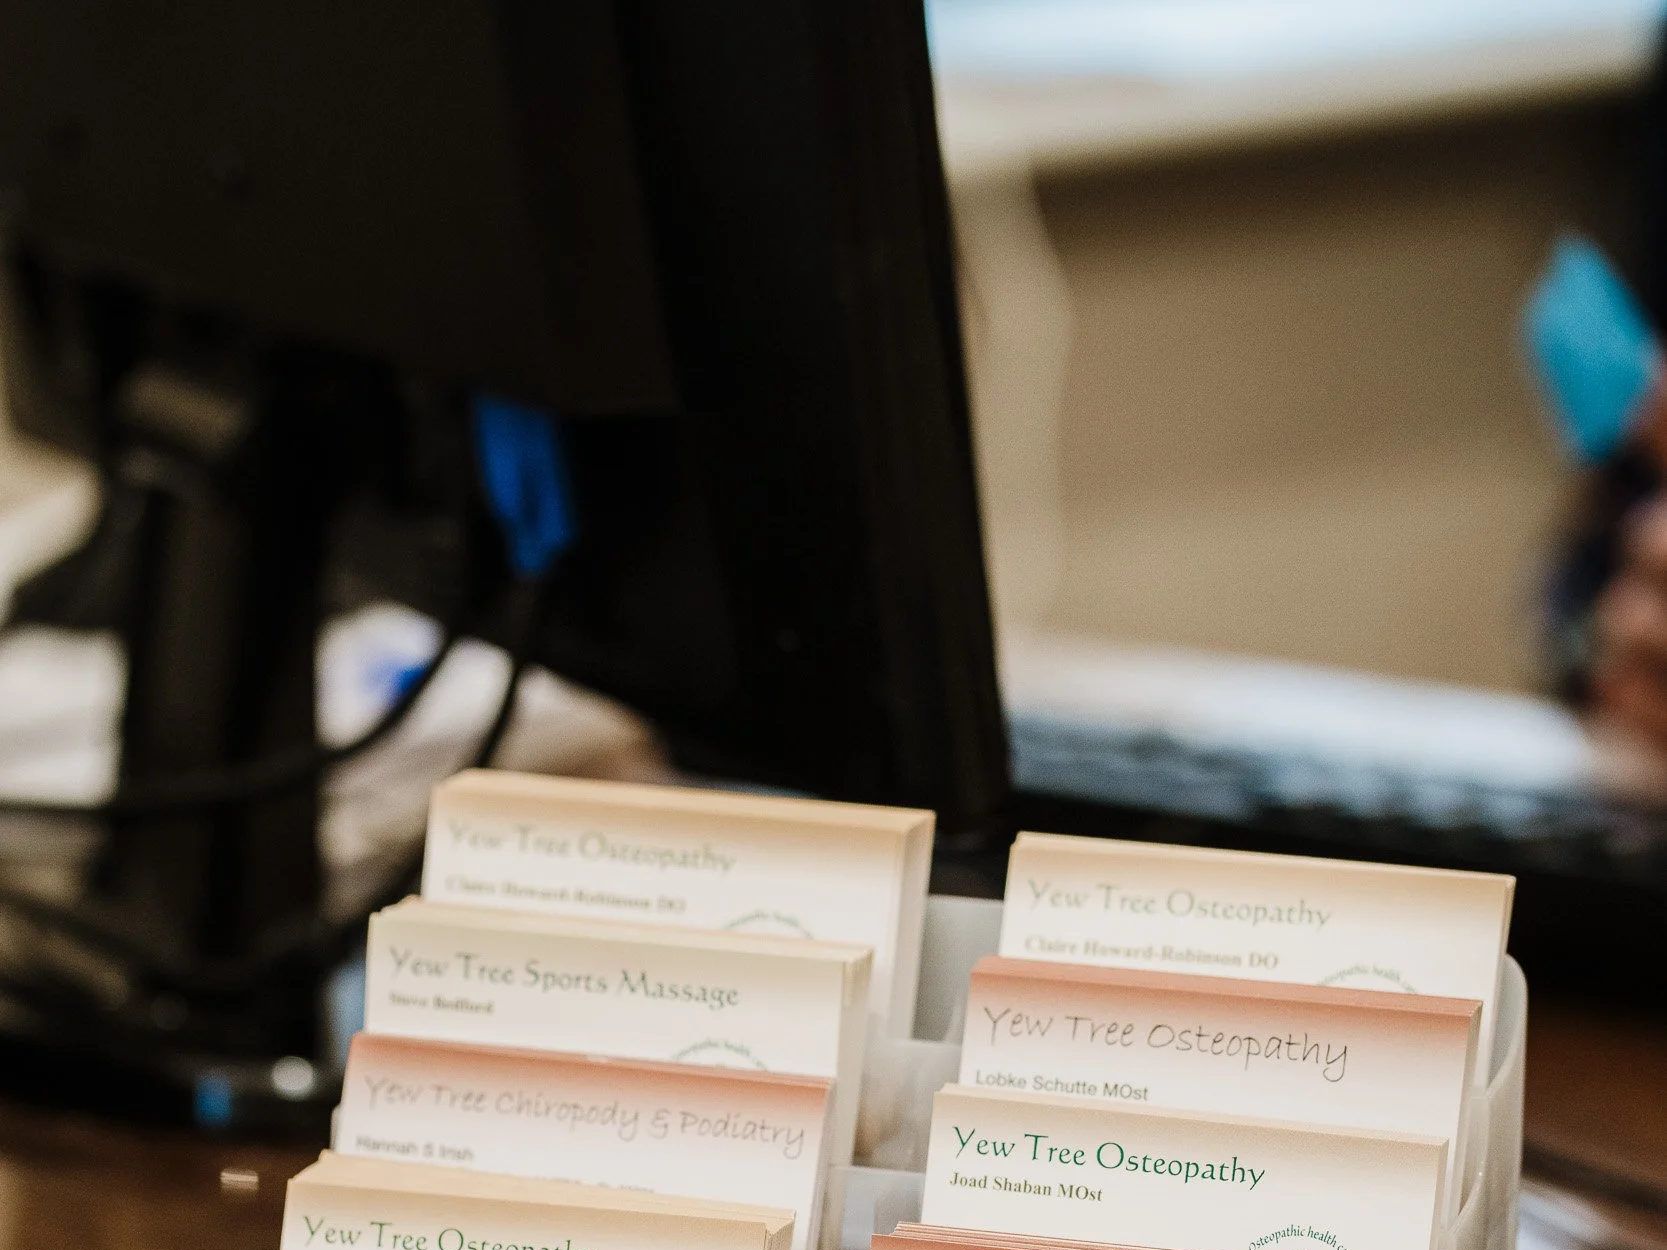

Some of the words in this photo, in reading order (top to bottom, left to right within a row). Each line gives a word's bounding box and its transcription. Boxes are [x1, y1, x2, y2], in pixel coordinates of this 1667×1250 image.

[447, 818, 507, 850] Yew
[512, 822, 570, 853] Tree
[577, 830, 738, 875] Osteopathy
[1028, 879, 1089, 911] Yew
[1095, 883, 1157, 915] Tree
[1166, 887, 1333, 931] Osteopathy
[388, 945, 449, 980] Yew
[455, 950, 515, 986] Tree
[523, 958, 608, 994] Sports
[616, 969, 740, 1011] Massage
[1248, 952, 1280, 970] DO
[984, 1006, 1053, 1046] Yew
[1064, 1015, 1134, 1048] Tree
[1147, 1023, 1348, 1083] Osteopathy
[975, 1069, 1027, 1089] Lobke
[1032, 1074, 1097, 1096] Schutte
[1102, 1083, 1149, 1102] MOst
[364, 1075, 423, 1110] Yew
[433, 1084, 488, 1114] Tree
[494, 1090, 641, 1141] Chiropody
[648, 1108, 672, 1139] &
[680, 1110, 806, 1160] Podiatry
[952, 1125, 1015, 1159] Yew
[1023, 1133, 1086, 1166] Tree
[1096, 1142, 1265, 1192] Osteopathy
[949, 1171, 988, 1190] Joad
[992, 1177, 1052, 1197] Shaban
[1057, 1183, 1103, 1203] MOst
[303, 1216, 362, 1247] Yew
[1307, 1225, 1336, 1249] health
